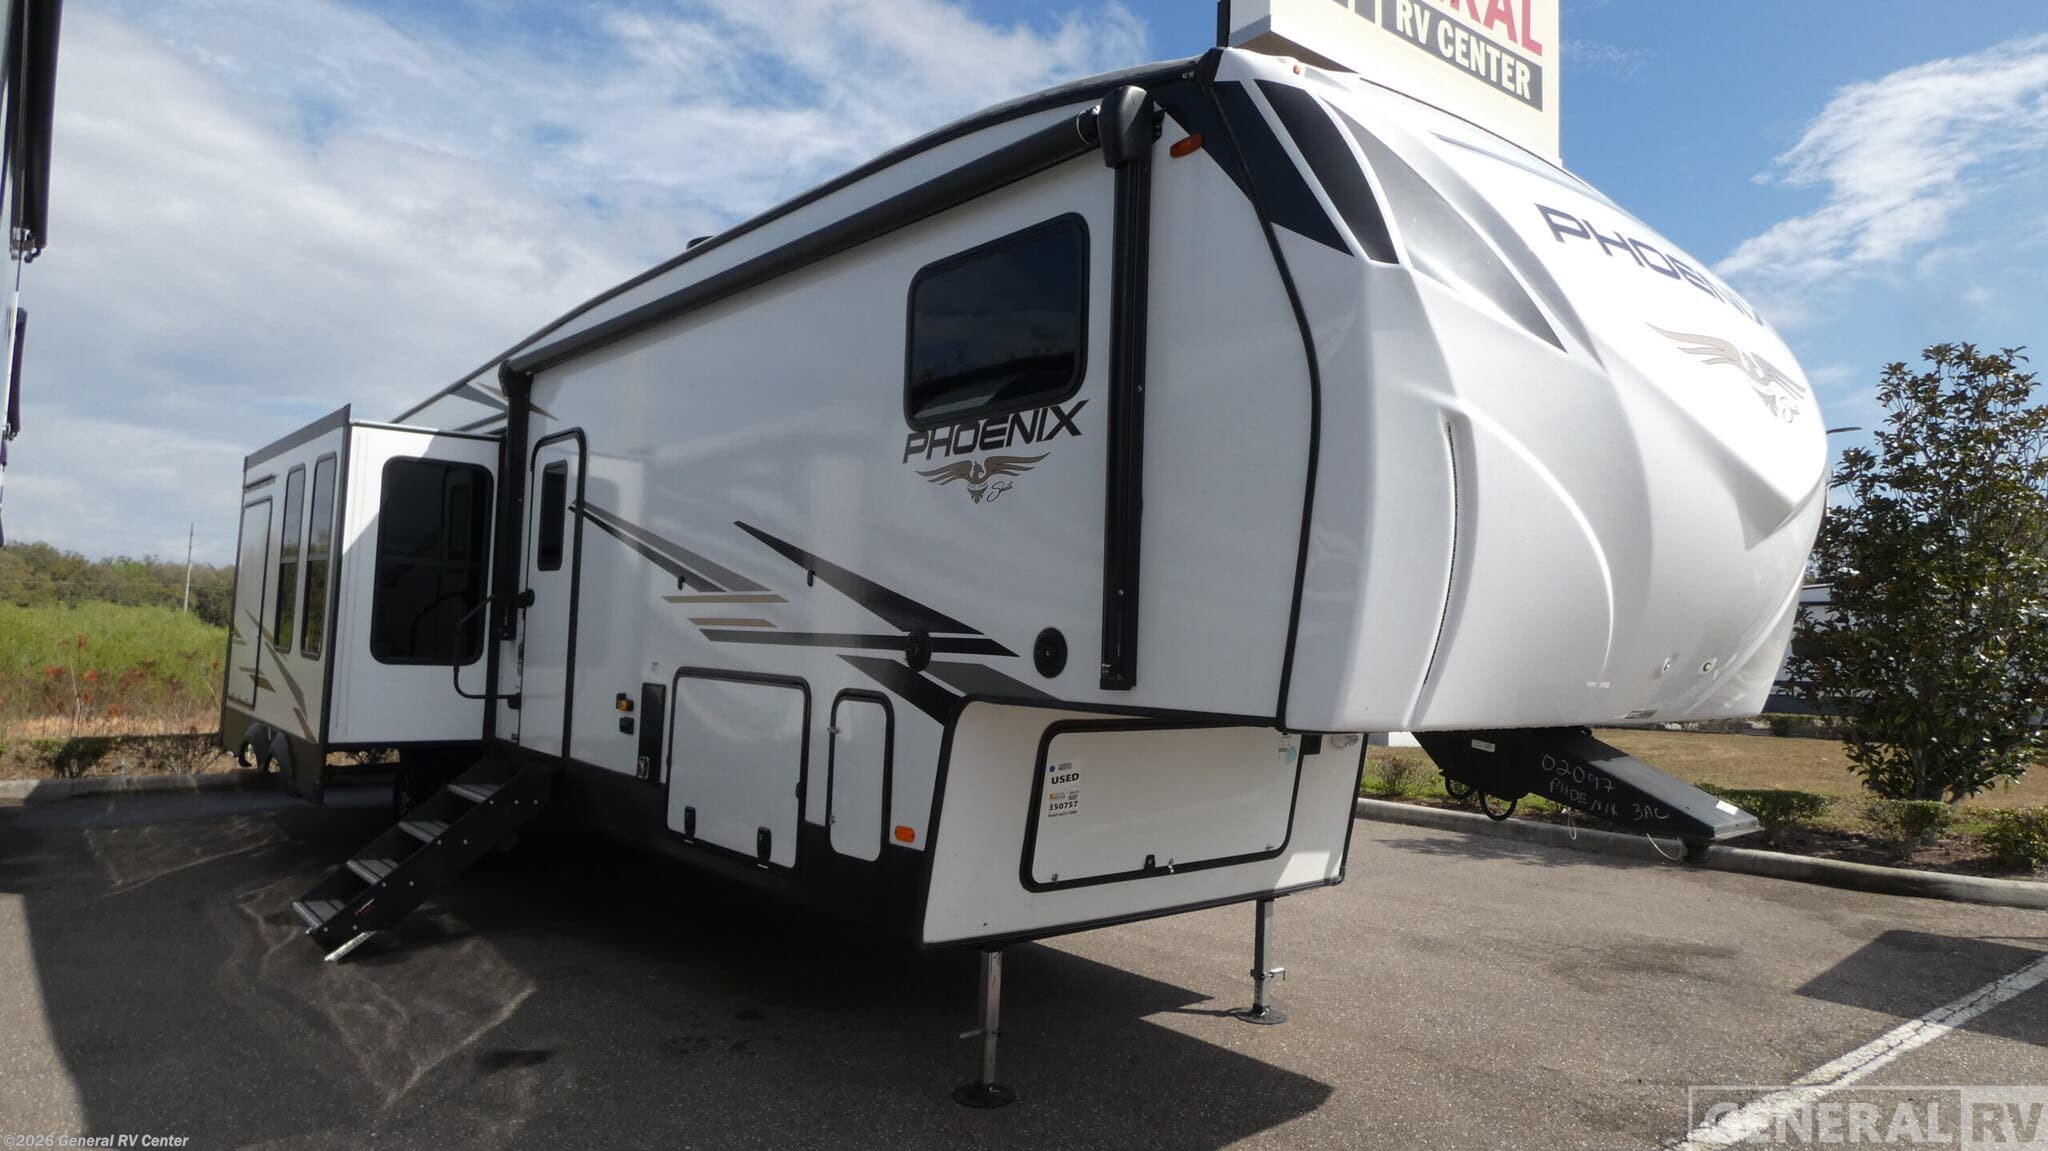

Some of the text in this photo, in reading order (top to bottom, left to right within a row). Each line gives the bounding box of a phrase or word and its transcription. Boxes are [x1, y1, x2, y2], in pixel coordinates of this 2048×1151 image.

[1396, 0, 1531, 100] RV CENTER
[903, 399, 1090, 465] PHOENIX
[1051, 773, 1079, 784] USED
[1542, 754, 1617, 793] 02097
[1048, 801, 1078, 811] 350757
